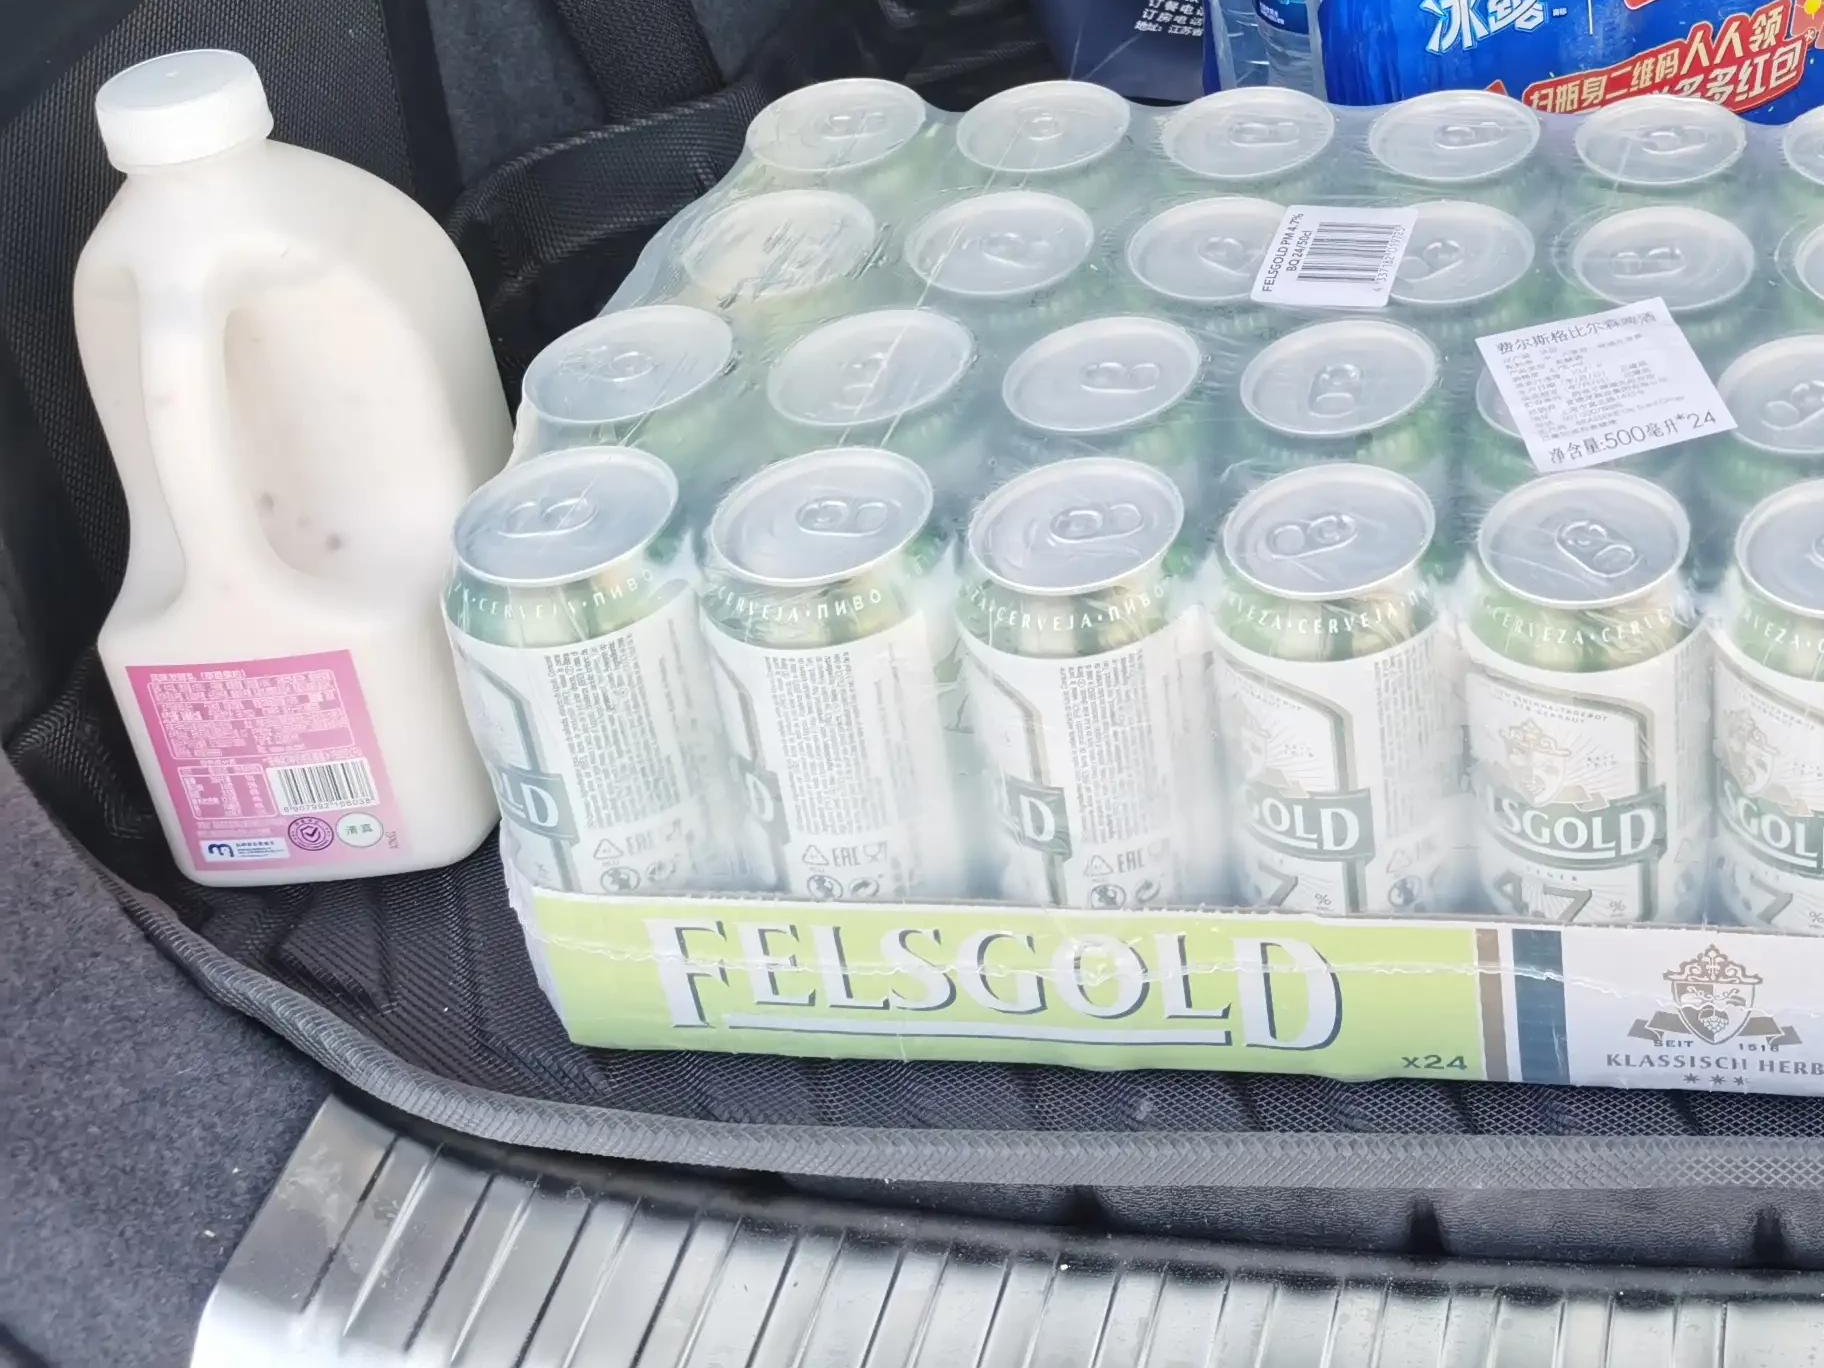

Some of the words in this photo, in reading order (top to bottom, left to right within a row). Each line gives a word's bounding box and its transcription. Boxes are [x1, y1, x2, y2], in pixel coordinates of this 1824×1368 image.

[1262, 250, 1288, 292] FELSGOLD
[817, 588, 883, 620] ПИВО
[996, 606, 1093, 631] CERVEJA
[1298, 606, 1398, 634] CERVEJA
[645, 917, 1344, 1051] FELSGOLD
[1653, 1039, 1696, 1049] SEIT
[1402, 1053, 1470, 1072] x24
[1606, 1052, 1748, 1072] KLASSISCH
